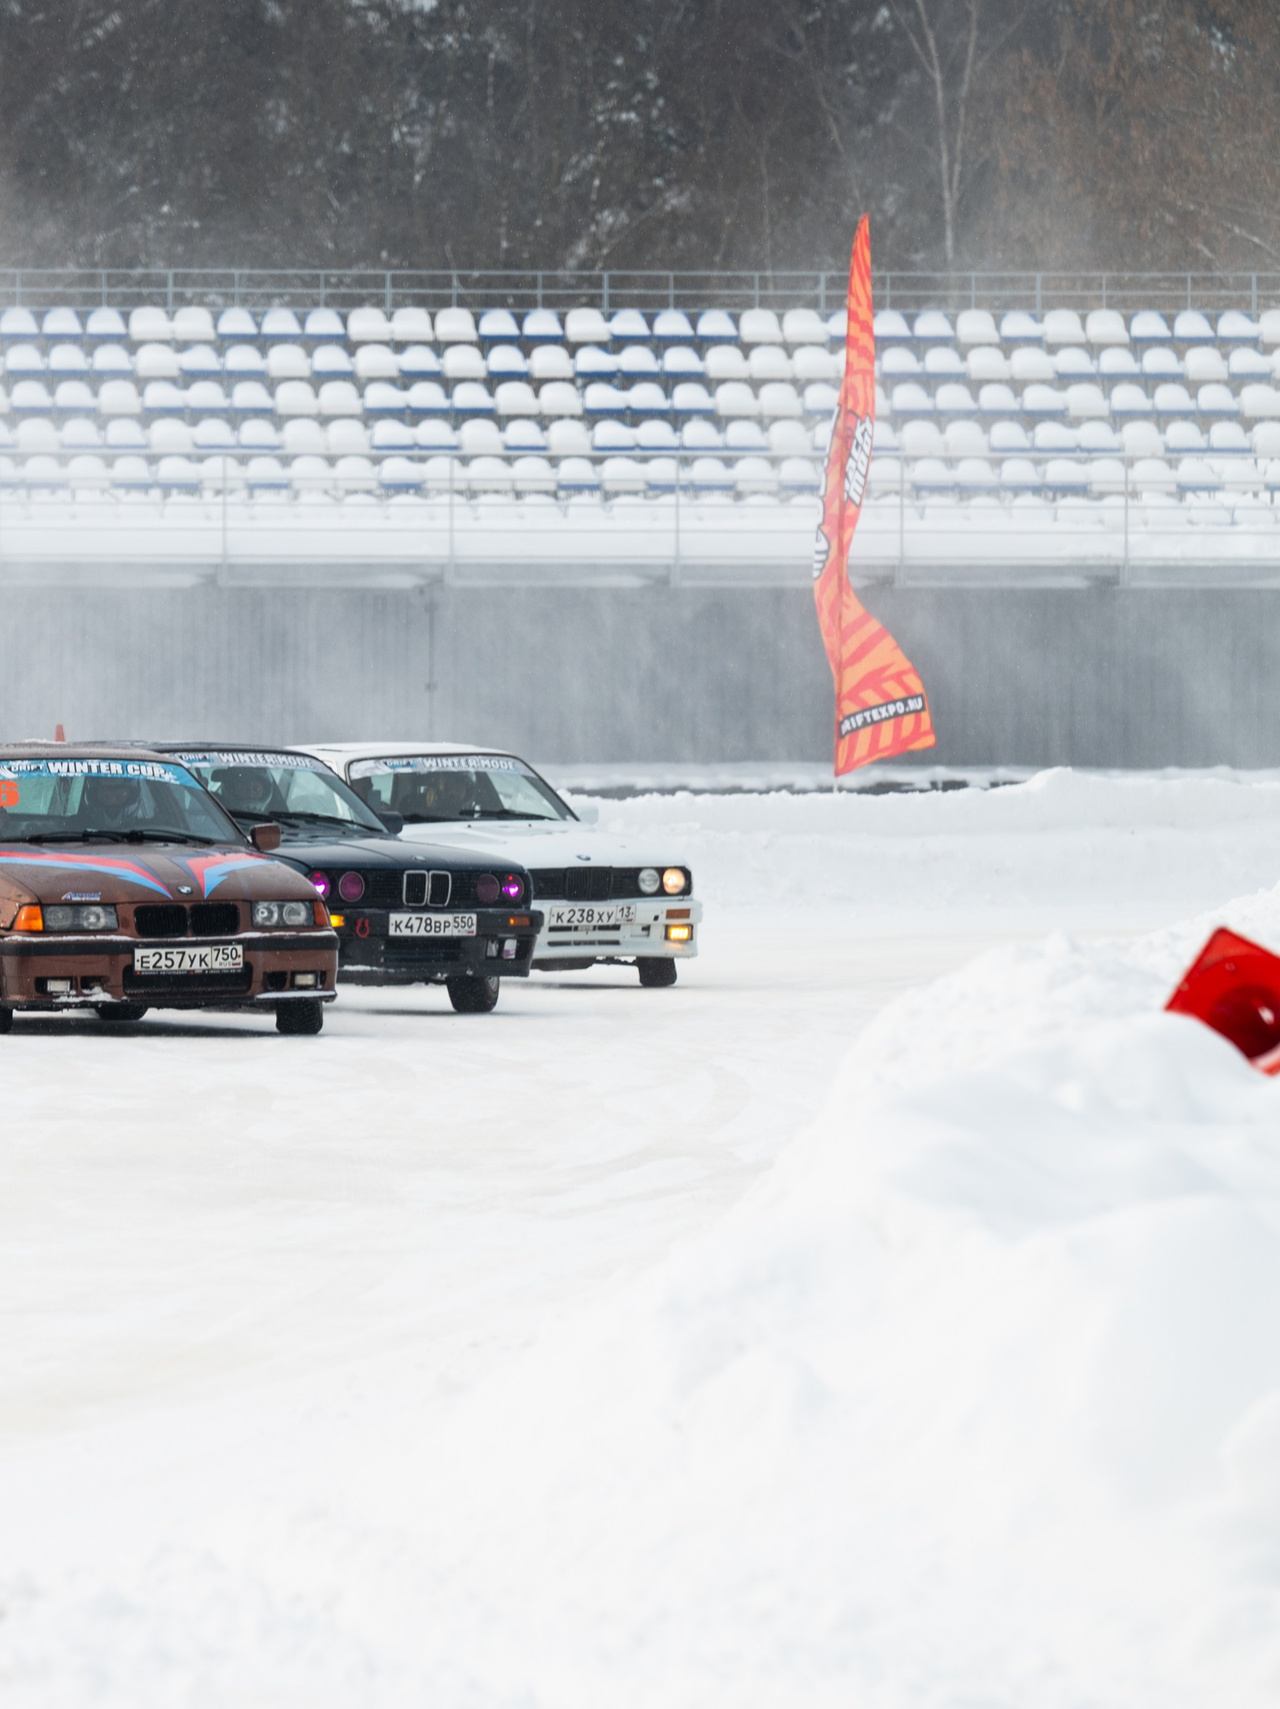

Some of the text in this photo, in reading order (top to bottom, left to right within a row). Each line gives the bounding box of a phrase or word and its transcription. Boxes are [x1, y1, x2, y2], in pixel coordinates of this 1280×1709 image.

[220, 753, 276, 764] WINTER
[278, 754, 313, 767] MODE
[422, 757, 479, 768] WINTER
[480, 758, 517, 770] MODE
[11, 761, 165, 778] DRIFT WINTER CUP
[618, 906, 631, 918] 13
[453, 916, 474, 928] 550
[213, 947, 238, 961] 750
